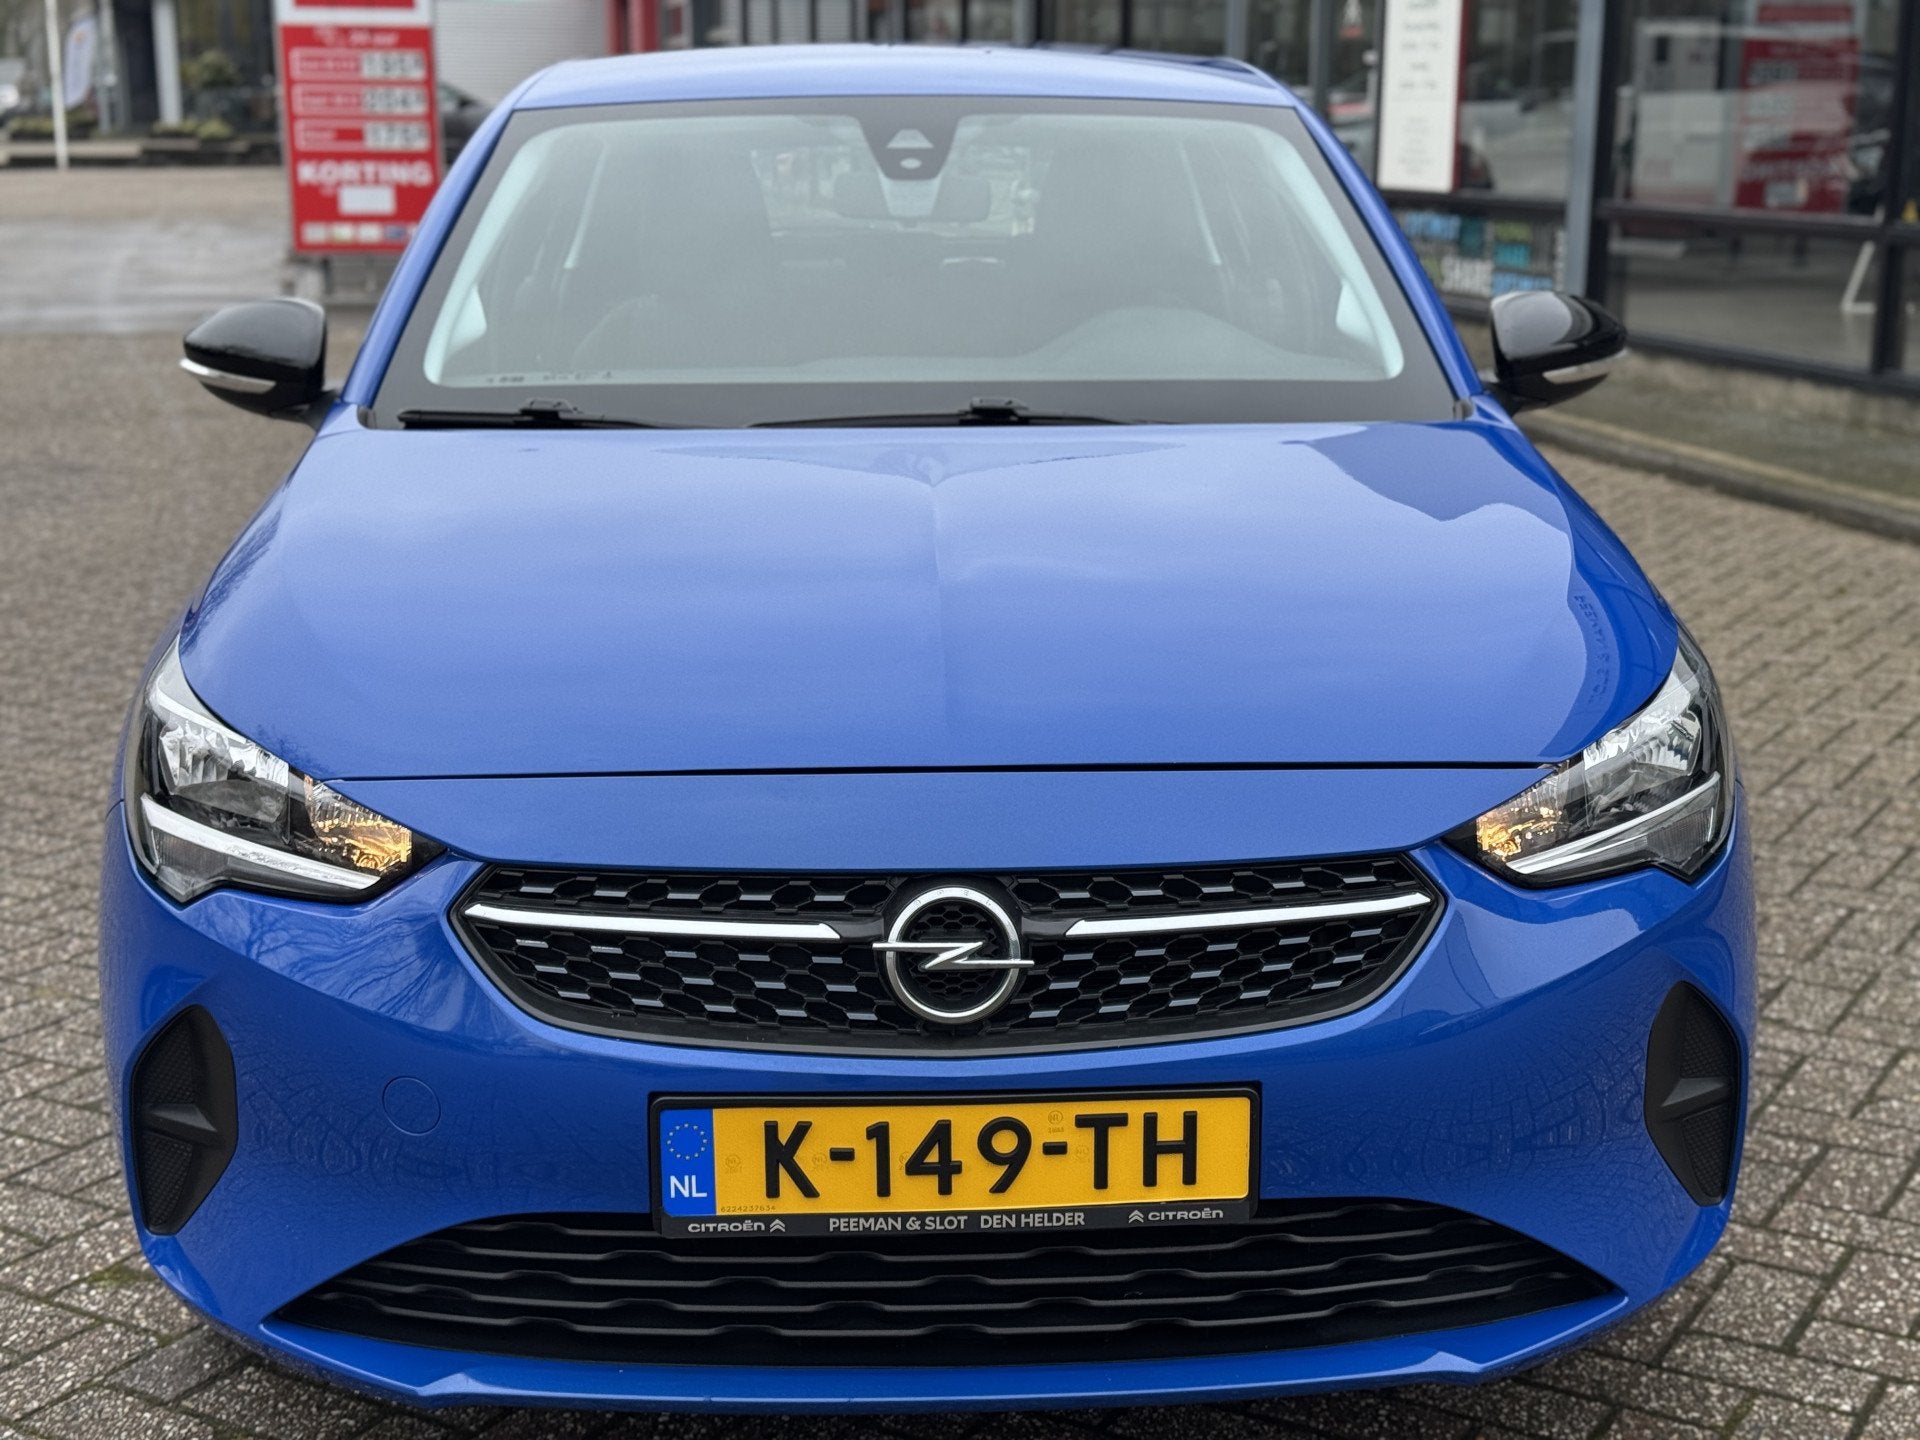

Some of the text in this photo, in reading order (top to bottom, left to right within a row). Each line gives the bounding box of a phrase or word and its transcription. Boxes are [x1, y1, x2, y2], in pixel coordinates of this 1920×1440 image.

[298, 160, 433, 187] KORTING
[763, 1111, 1198, 1198] K-149-TH
[670, 1175, 708, 1198] NL
[829, 1212, 1086, 1232] PEEMAN & SLOT DEN HELDER
